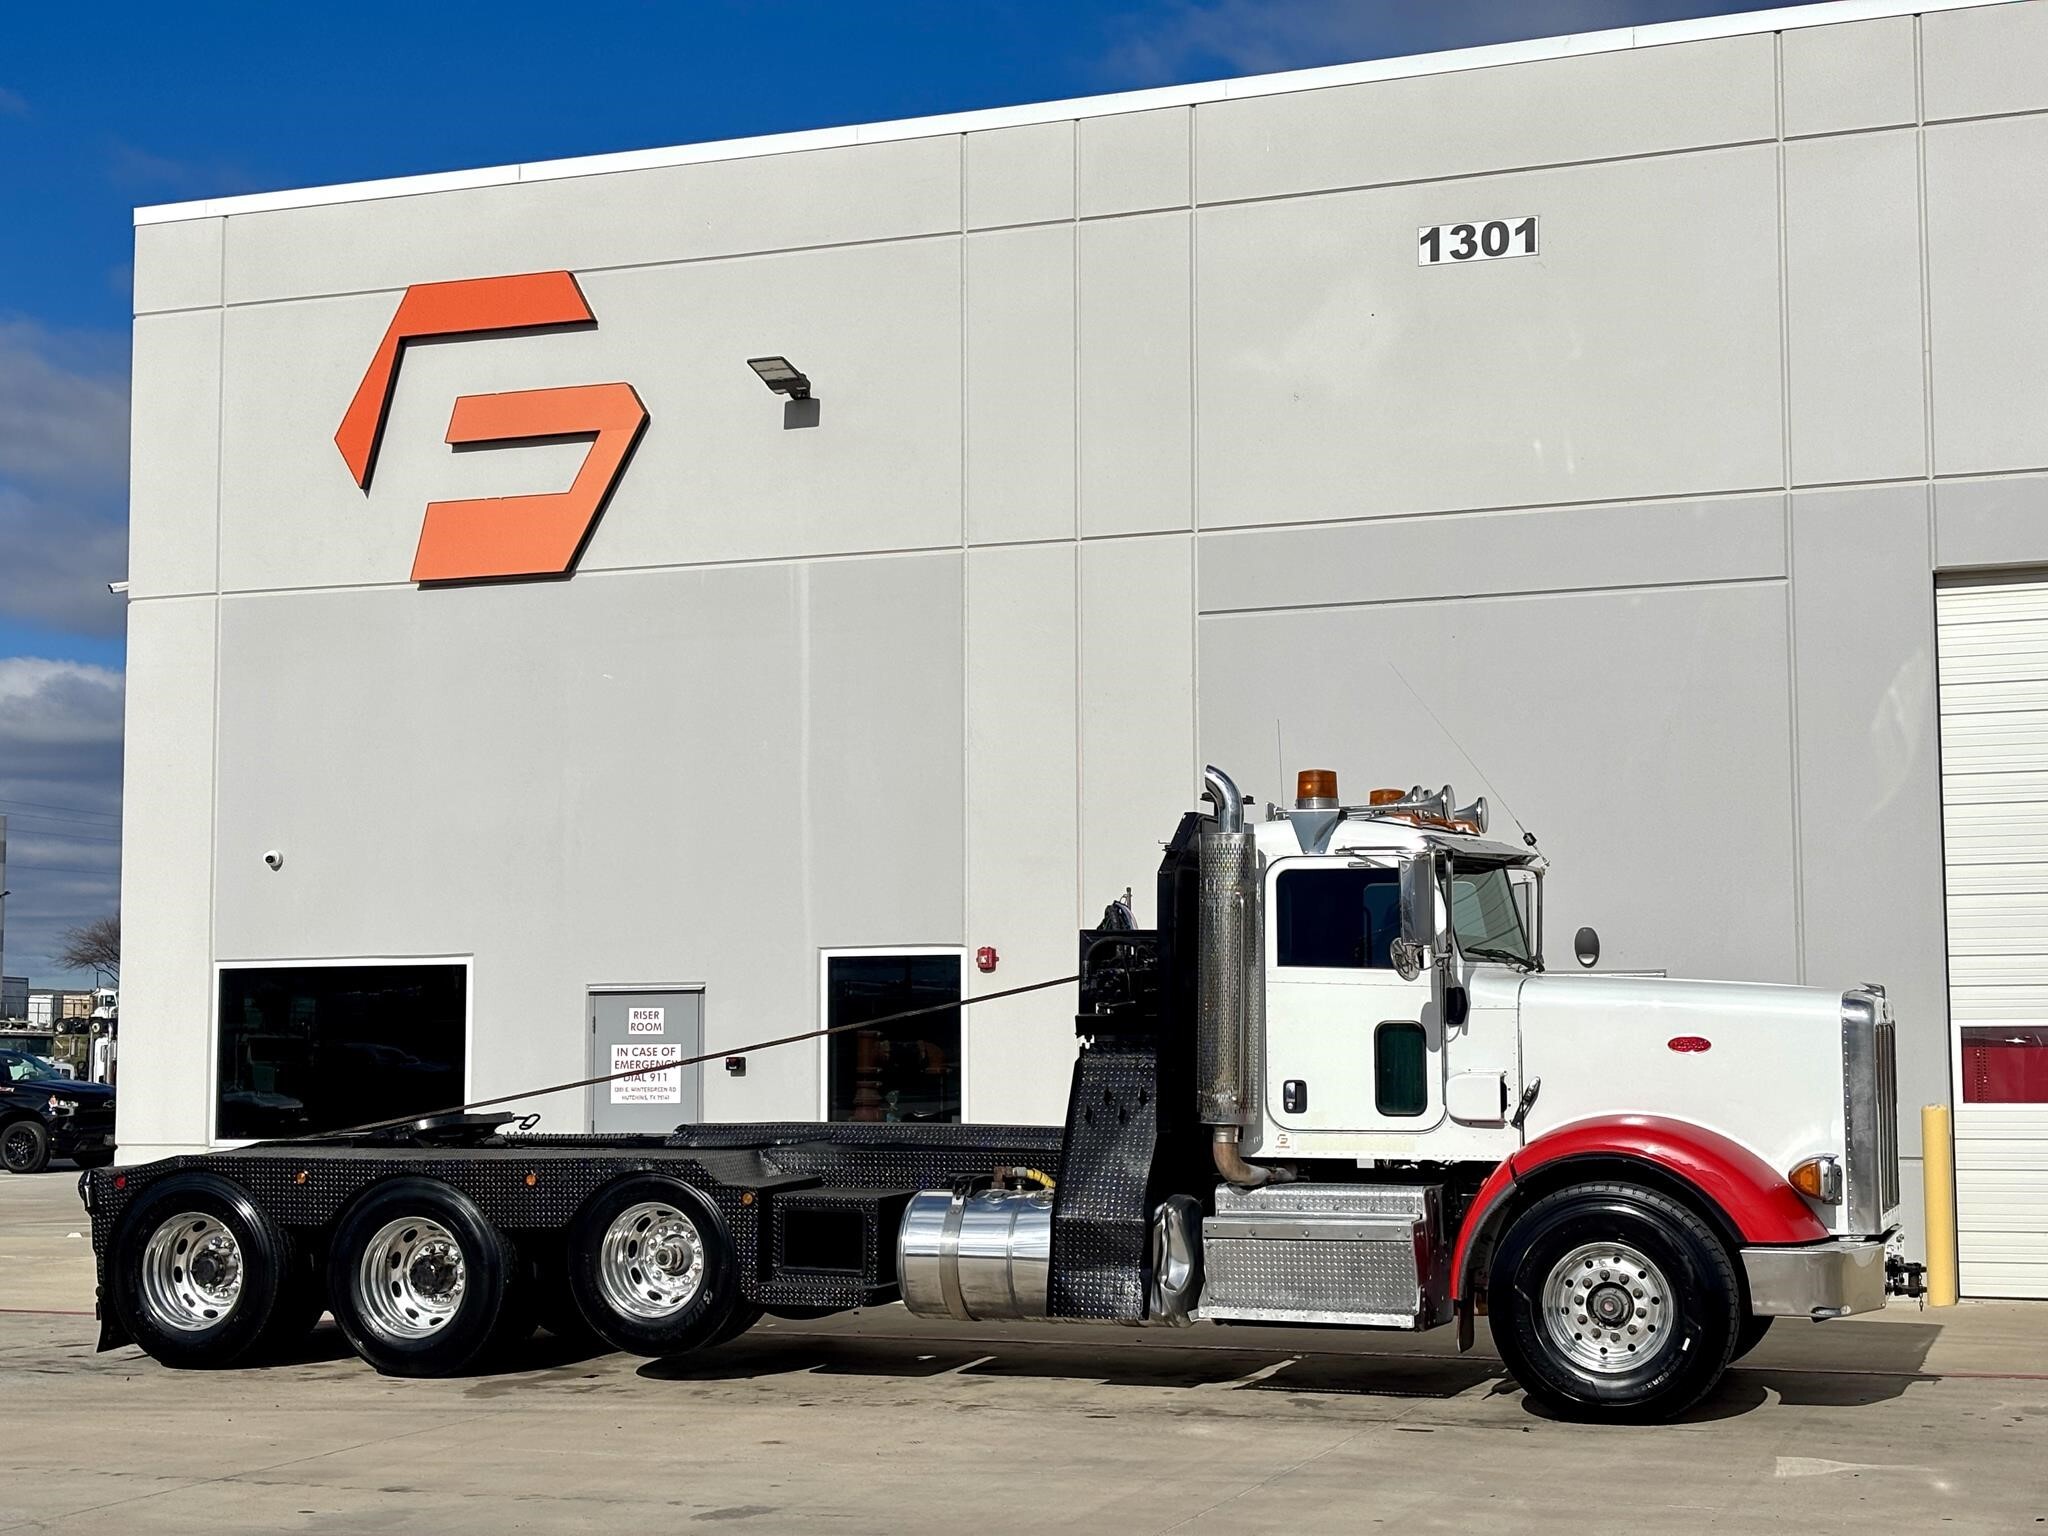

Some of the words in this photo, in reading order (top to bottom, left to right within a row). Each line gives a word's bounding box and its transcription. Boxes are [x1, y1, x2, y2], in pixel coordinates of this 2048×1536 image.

[1420, 217, 1536, 262] 1301
[633, 1011, 660, 1020] RISER
[630, 1022, 662, 1031] ROOM
[617, 1047, 628, 1056] IN
[632, 1047, 658, 1056] CASE
[661, 1047, 676, 1056] OF
[650, 1073, 668, 1082] 911
